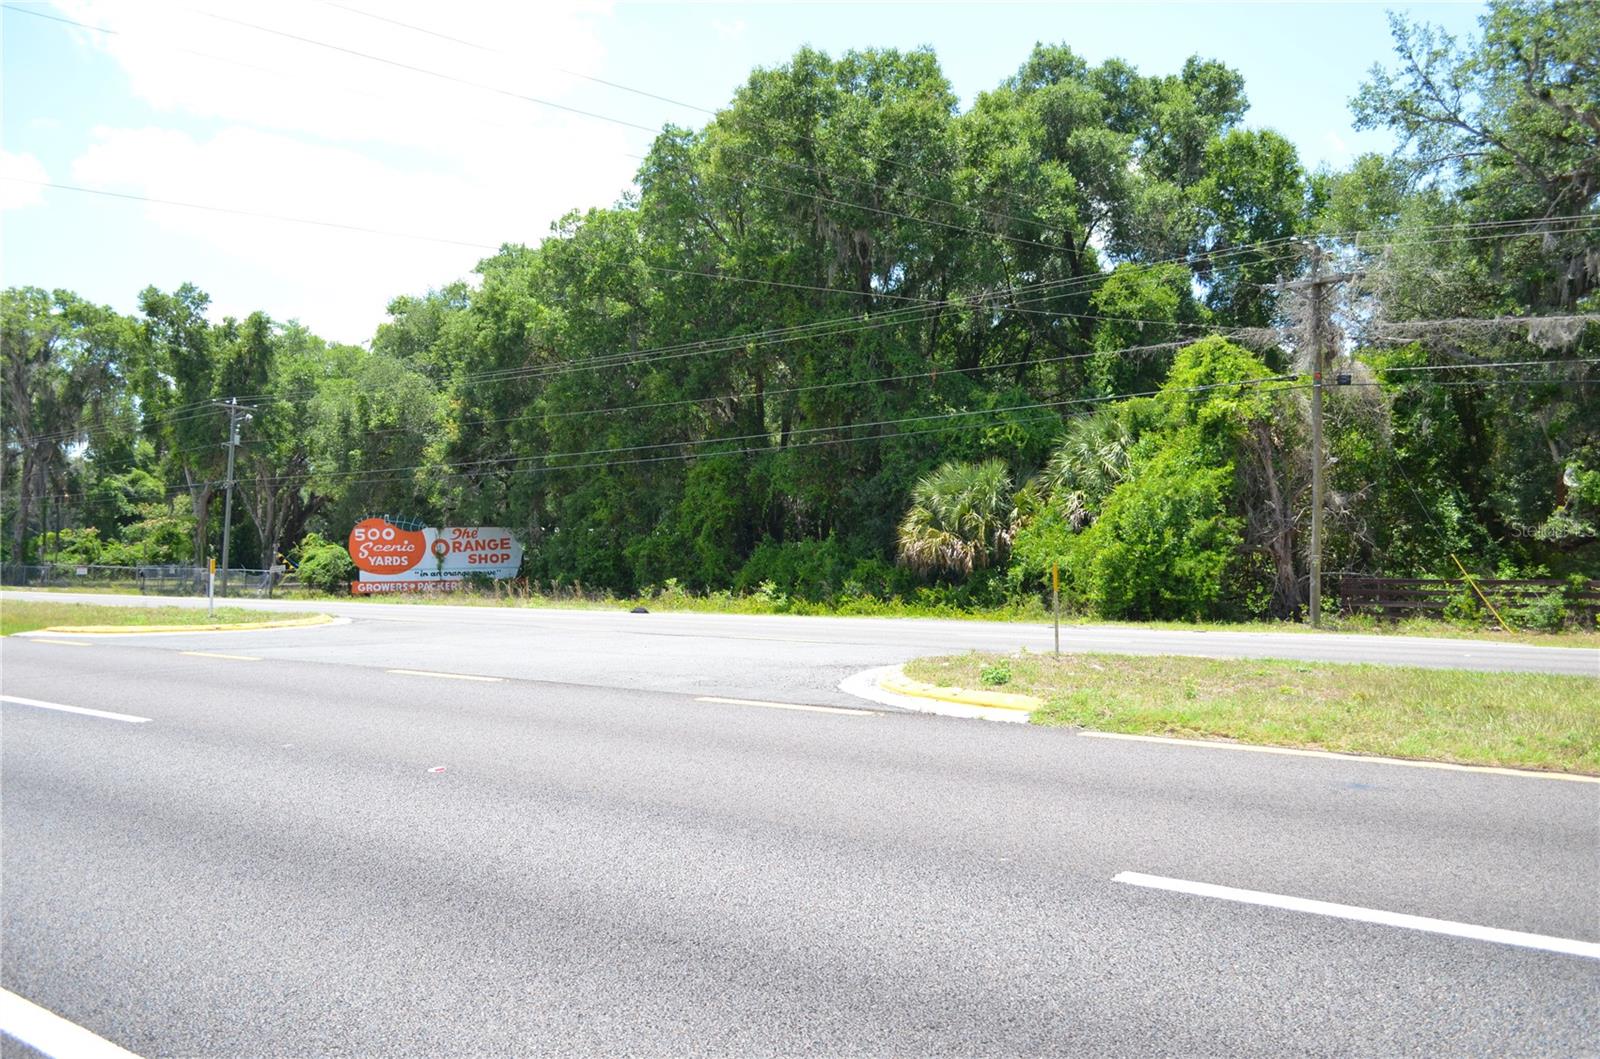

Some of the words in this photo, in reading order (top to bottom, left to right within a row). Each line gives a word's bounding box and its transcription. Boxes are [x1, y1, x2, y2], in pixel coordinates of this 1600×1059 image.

[354, 528, 395, 541] 500
[450, 527, 479, 541] The
[358, 540, 415, 559] Scenic
[431, 537, 512, 558] ORANGE
[368, 556, 409, 566] YARDS
[468, 553, 511, 565] SHOP
[357, 583, 408, 592] GROWERS
